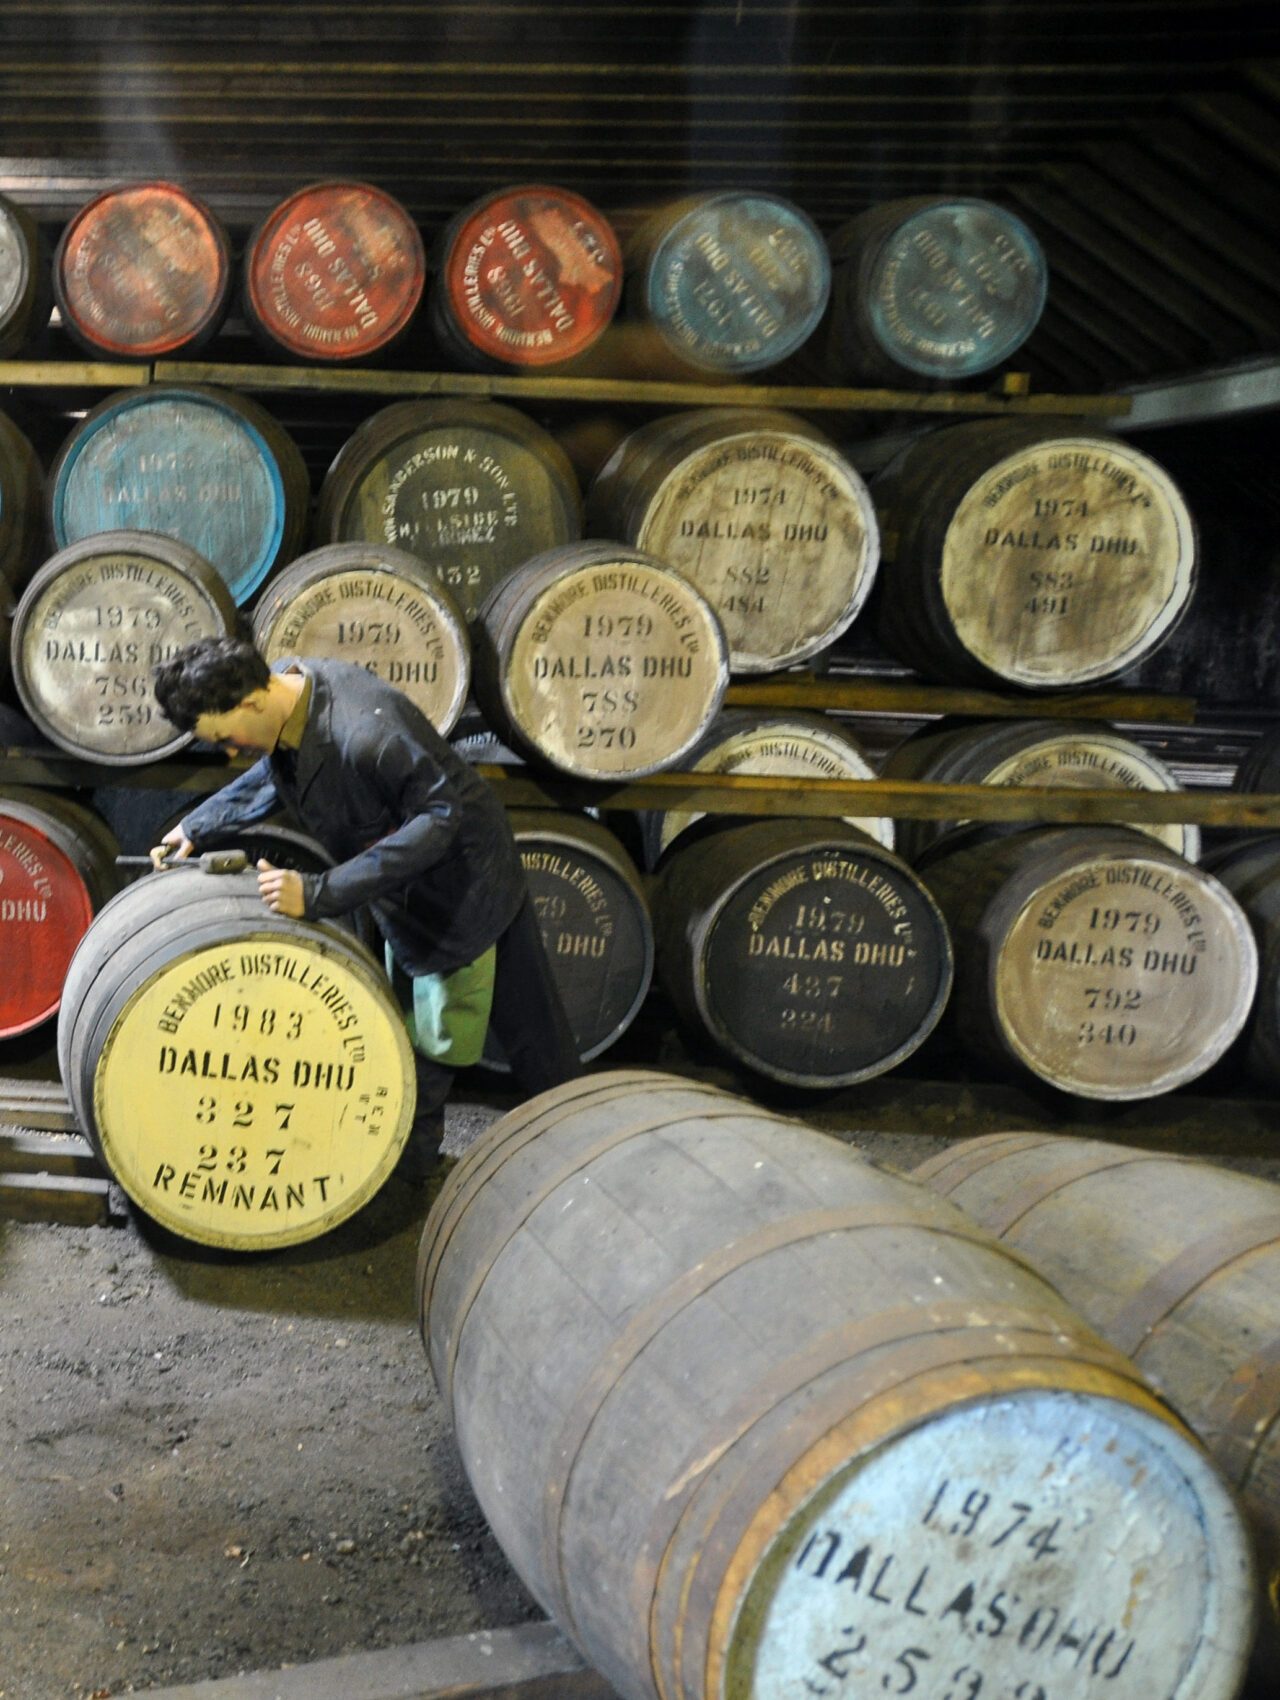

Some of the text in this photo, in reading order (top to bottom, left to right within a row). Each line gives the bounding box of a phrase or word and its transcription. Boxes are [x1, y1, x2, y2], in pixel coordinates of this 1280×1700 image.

[303, 217, 336, 257] DHU
[694, 230, 729, 271] DHU
[497, 217, 574, 331] DALLAS DHU
[329, 258, 377, 326] DALLAS
[723, 270, 778, 337] DALLAS
[732, 488, 787, 506] 1974
[1032, 498, 1089, 518] 1974
[679, 520, 828, 541] DALLAS DHU
[983, 528, 1138, 556] DALLAS DHU
[100, 564, 193, 617] DISTILLERIES
[94, 605, 160, 630] 1979
[281, 580, 432, 649] BENMORE DISTILLERIES
[531, 574, 692, 645] BENMORE DISTILLERIES
[581, 614, 654, 638] 1979
[337, 622, 401, 644] 1979
[45, 641, 138, 664] DALLAS
[533, 654, 692, 679] DALLAS DHU
[388, 660, 437, 684] DHU
[576, 725, 636, 749] 270
[813, 859, 908, 921] DISTILLERIES
[1040, 865, 1202, 932] BENMORE DISTILLERIES
[0, 898, 47, 923] DHU
[1085, 907, 1161, 934] 1979
[556, 932, 605, 959] DHU
[749, 933, 904, 968] DALLAS DHU
[1035, 939, 1197, 976] DALLAS DHU
[158, 960, 235, 1034] BENMORE
[241, 954, 358, 1031] DISTILLERIES
[1083, 988, 1143, 1011] 792
[213, 1004, 304, 1040] 1983
[159, 1046, 355, 1090] DALLAS DHU
[153, 1164, 330, 1211] REMNANT
[922, 1480, 1062, 1560] 1974
